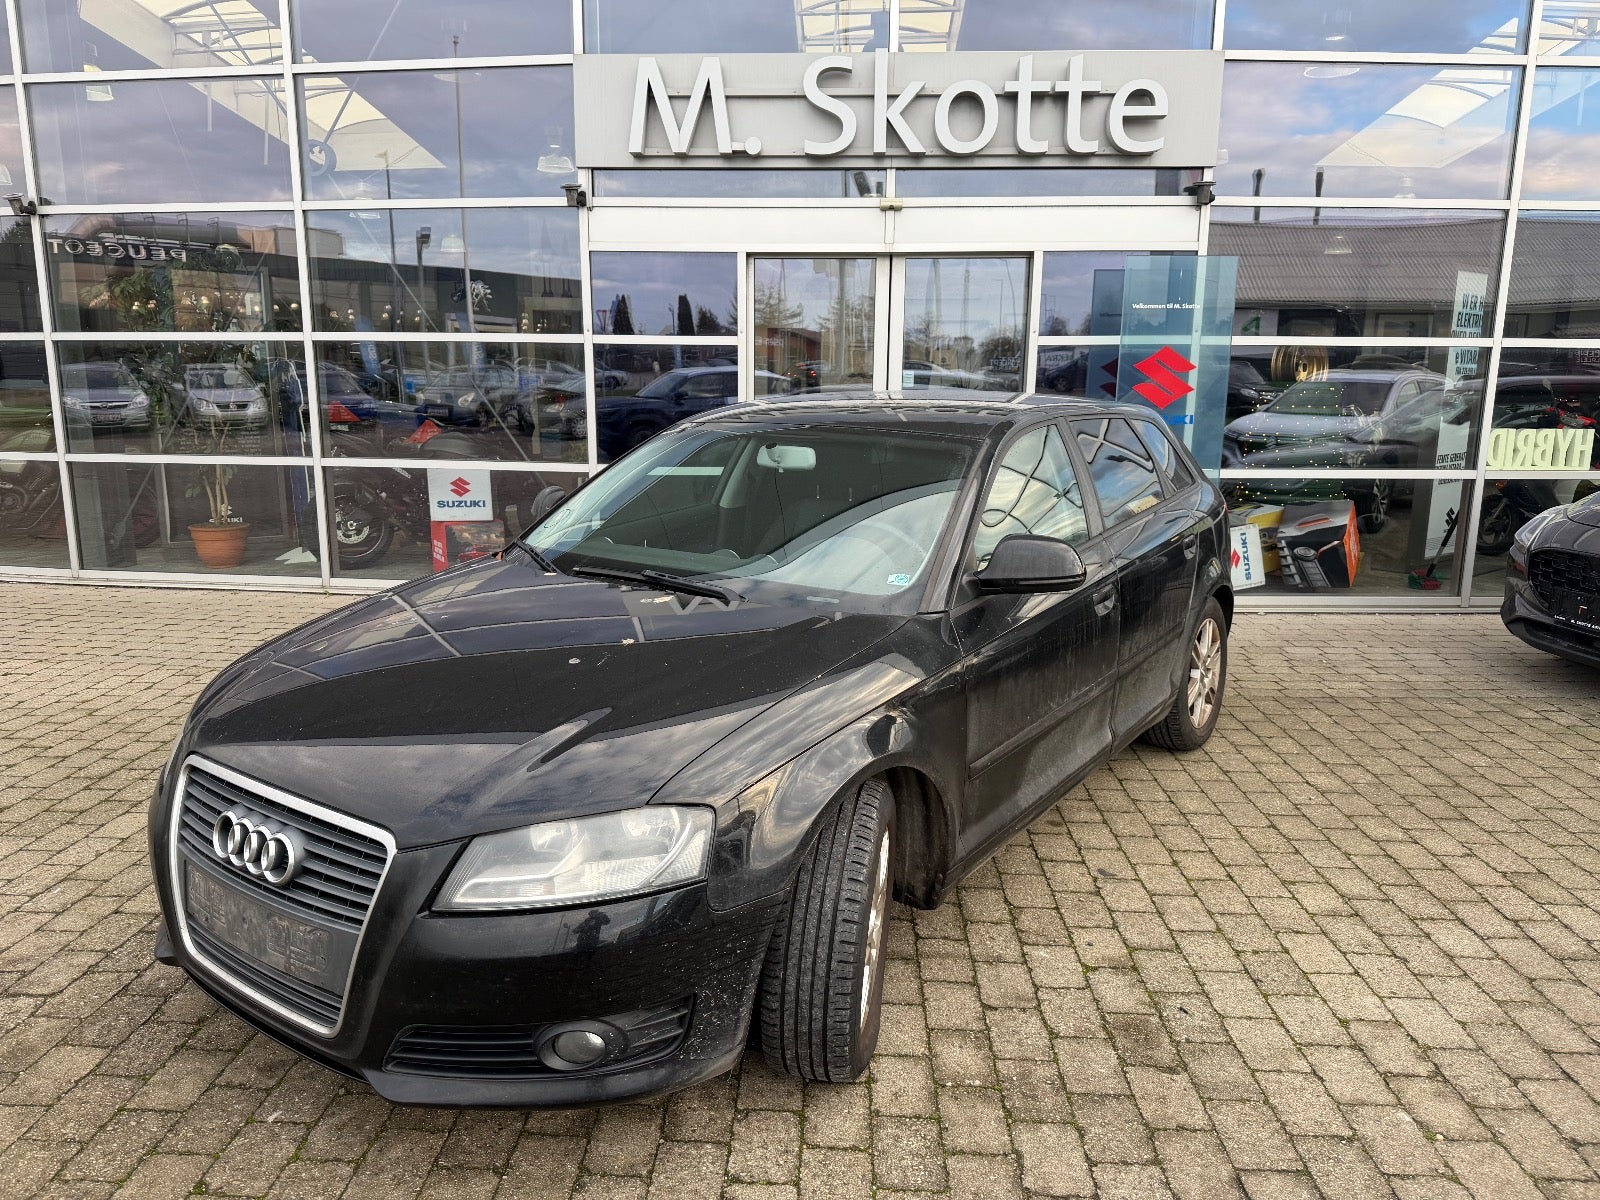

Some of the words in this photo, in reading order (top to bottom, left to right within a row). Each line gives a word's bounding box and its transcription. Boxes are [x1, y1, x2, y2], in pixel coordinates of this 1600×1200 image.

[628, 56, 762, 157] M.
[802, 48, 1169, 157] Skotte
[437, 500, 486, 508] SUZUKI
[1240, 532, 1252, 581] SUZUKI
